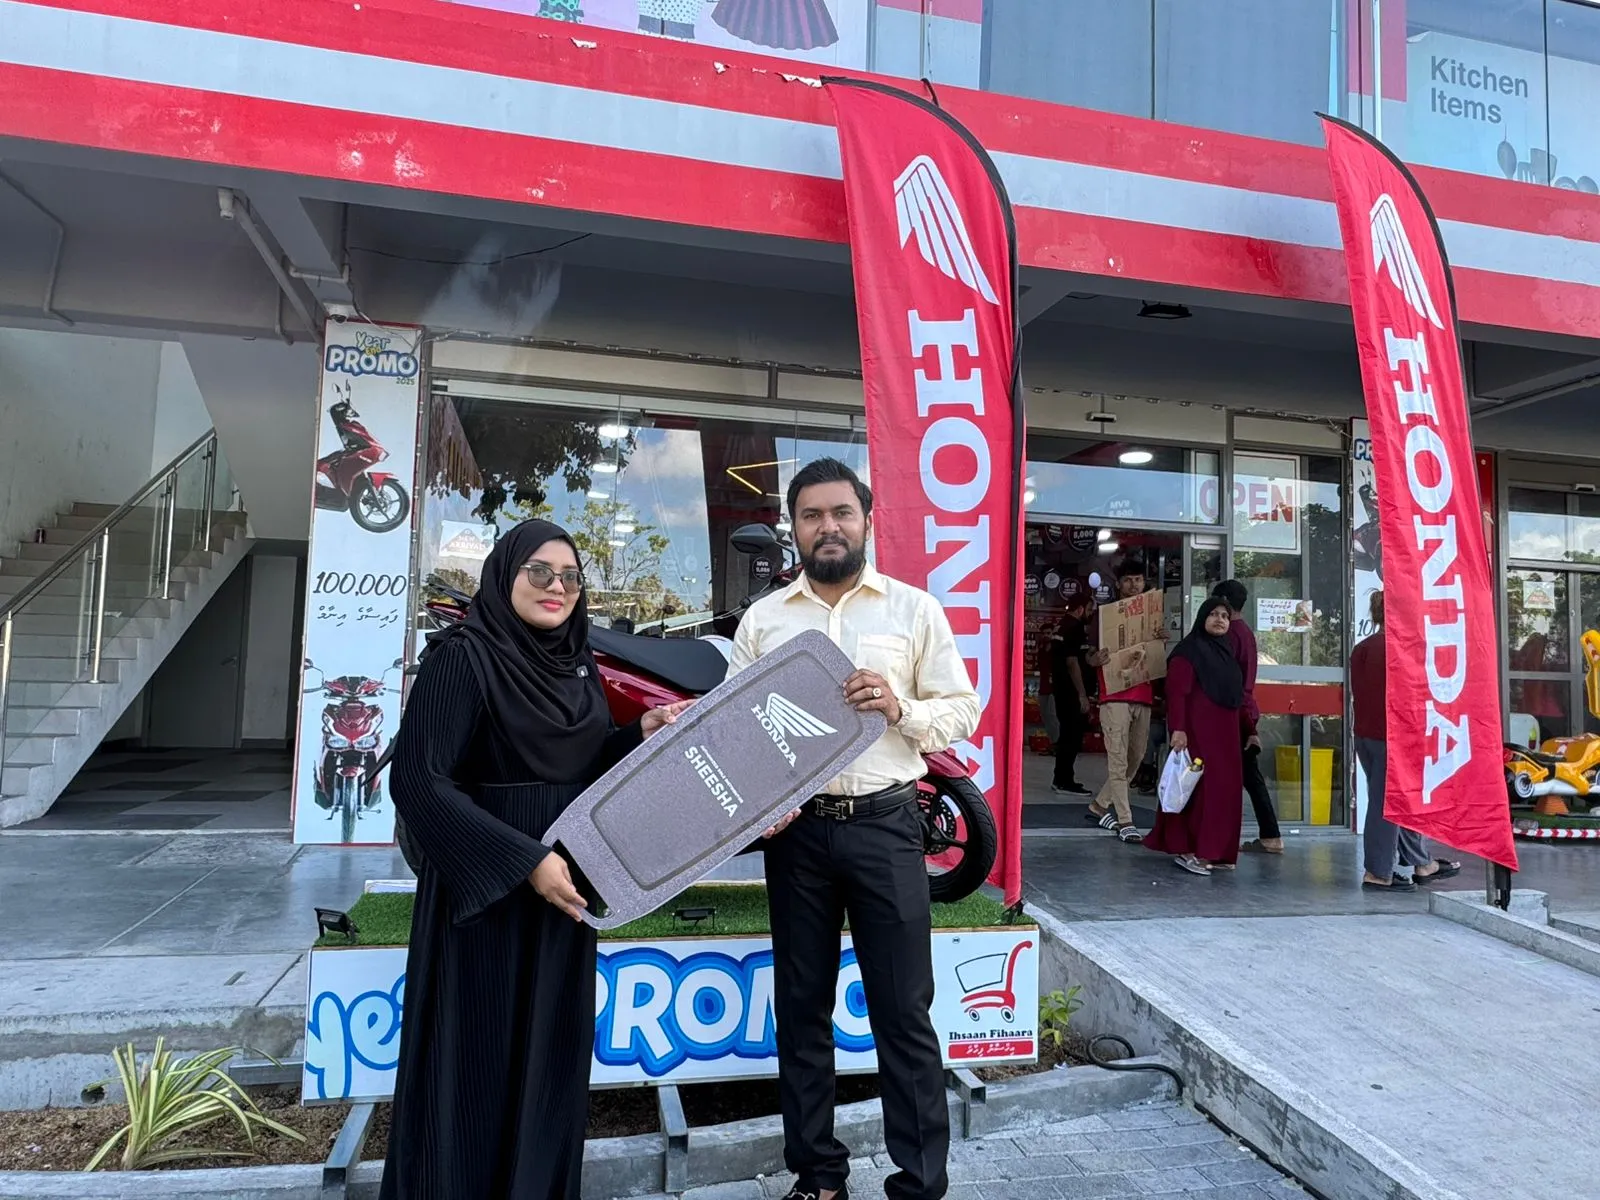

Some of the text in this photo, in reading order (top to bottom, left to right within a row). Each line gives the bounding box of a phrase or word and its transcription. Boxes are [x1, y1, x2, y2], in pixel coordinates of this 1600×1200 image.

[1431, 55, 1528, 98] Kitchen
[1431, 87, 1502, 124] Items
[327, 345, 418, 377] PROMO
[396, 377, 416, 386] 2025
[1199, 479, 1293, 523] OPEN
[313, 571, 407, 596] 100,000
[1383, 328, 1472, 805] HONDA
[750, 703, 798, 768] HONDA
[684, 746, 739, 818] SHEESHA
[949, 1029, 1033, 1040] Ihsaan Fihaara
